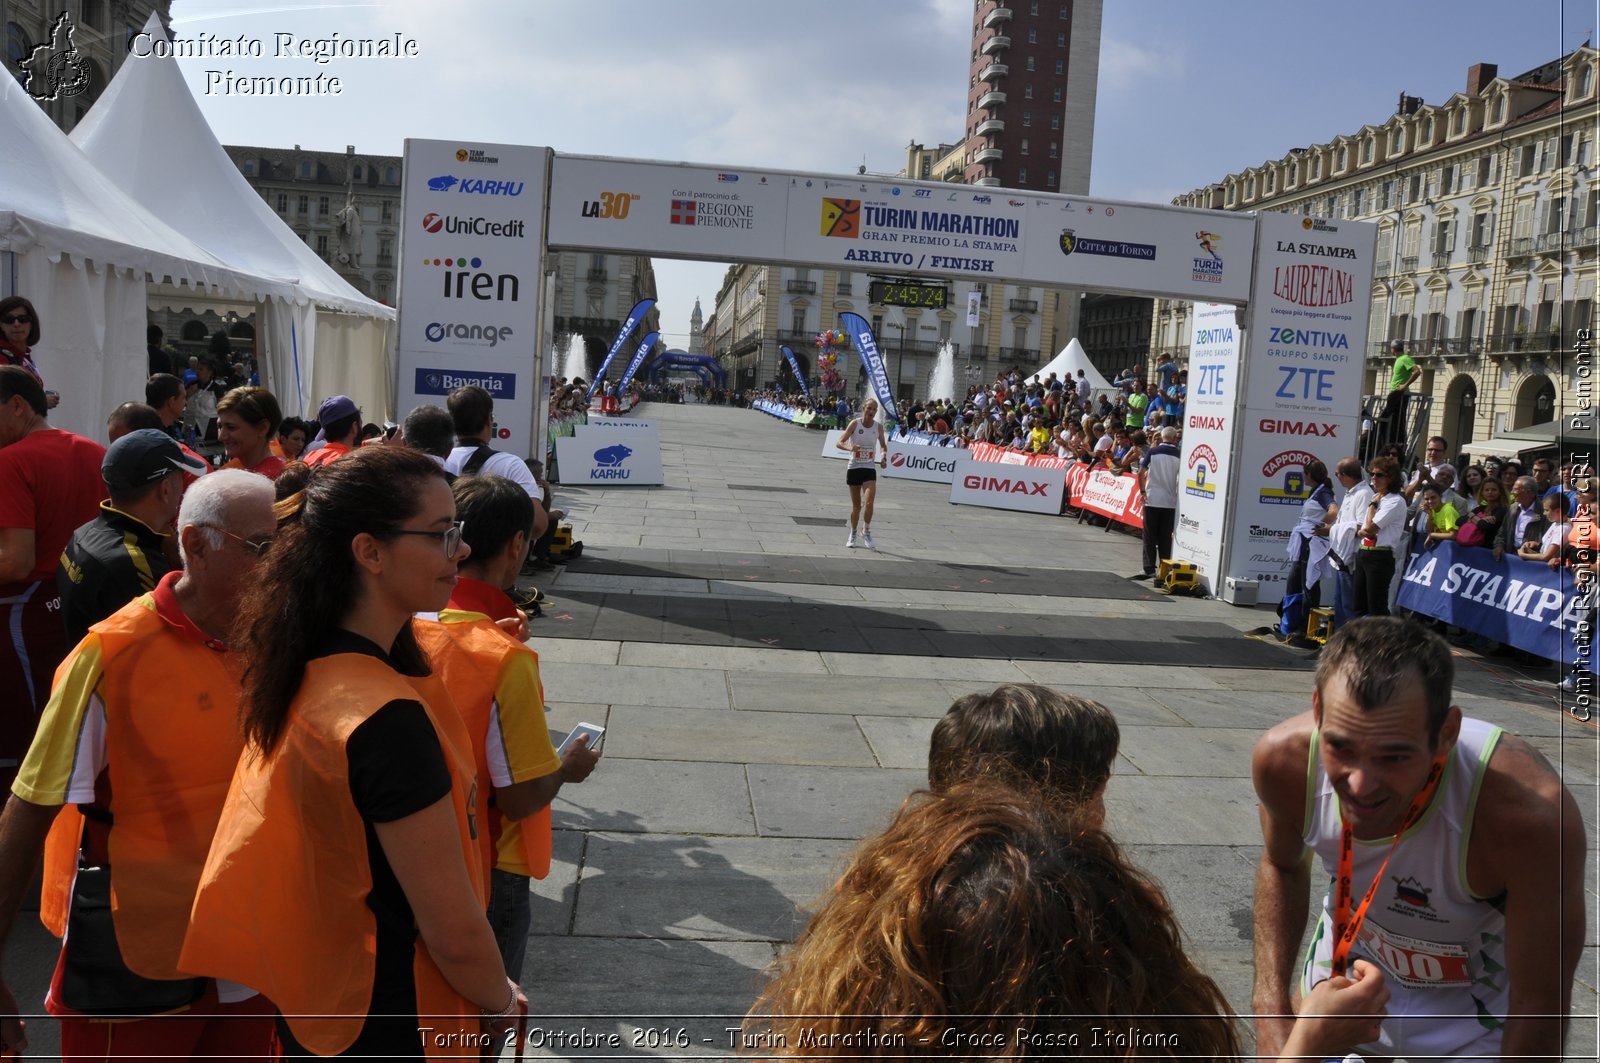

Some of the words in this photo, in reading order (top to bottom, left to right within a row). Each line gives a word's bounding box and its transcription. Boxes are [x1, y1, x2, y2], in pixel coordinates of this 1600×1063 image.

[469, 156, 499, 164] MARATHON
[458, 178, 524, 197] KARHU
[672, 189, 686, 198] Con
[687, 189, 693, 198] il
[693, 191, 730, 201] patrocinio
[698, 202, 754, 218] REGIONE
[445, 215, 525, 238] UniCredit
[696, 215, 753, 229] PIEMONTE
[864, 206, 918, 229] TURIN
[921, 211, 1019, 239] MARATHON
[862, 231, 898, 242] GRAN
[901, 234, 950, 247] PREMIO
[954, 238, 969, 248] LA
[972, 241, 1018, 252] STAMPA
[1277, 241, 1296, 253] LA
[1299, 243, 1357, 259] STAMPA
[844, 248, 914, 265] ARRIVO
[930, 255, 994, 272] FINISH
[1193, 259, 1223, 270] TURIN
[444, 260, 519, 301] iren
[1273, 264, 1353, 307] LAURETANA
[883, 284, 944, 305] 2:45:24
[1271, 307, 1292, 315] L'acqua
[1303, 310, 1325, 319] leggera
[1267, 348, 1308, 360] GRUPPO
[1313, 352, 1349, 363] SANOFI
[859, 332, 891, 400] Bavaria
[443, 374, 503, 391] Bavaria
[1197, 364, 1226, 395] ZTE
[1275, 366, 1335, 401] ZTE
[1189, 415, 1225, 431] GIMAX
[1259, 418, 1338, 438] GIMAX
[906, 456, 956, 473] UniCred
[1264, 453, 1313, 475] TAPPORO
[590, 469, 630, 479] KARHU
[963, 475, 1048, 497] GIMAX
[1402, 552, 1438, 587] LA
[1440, 562, 1584, 634] STAMPA
[45, 596, 61, 612] PO
